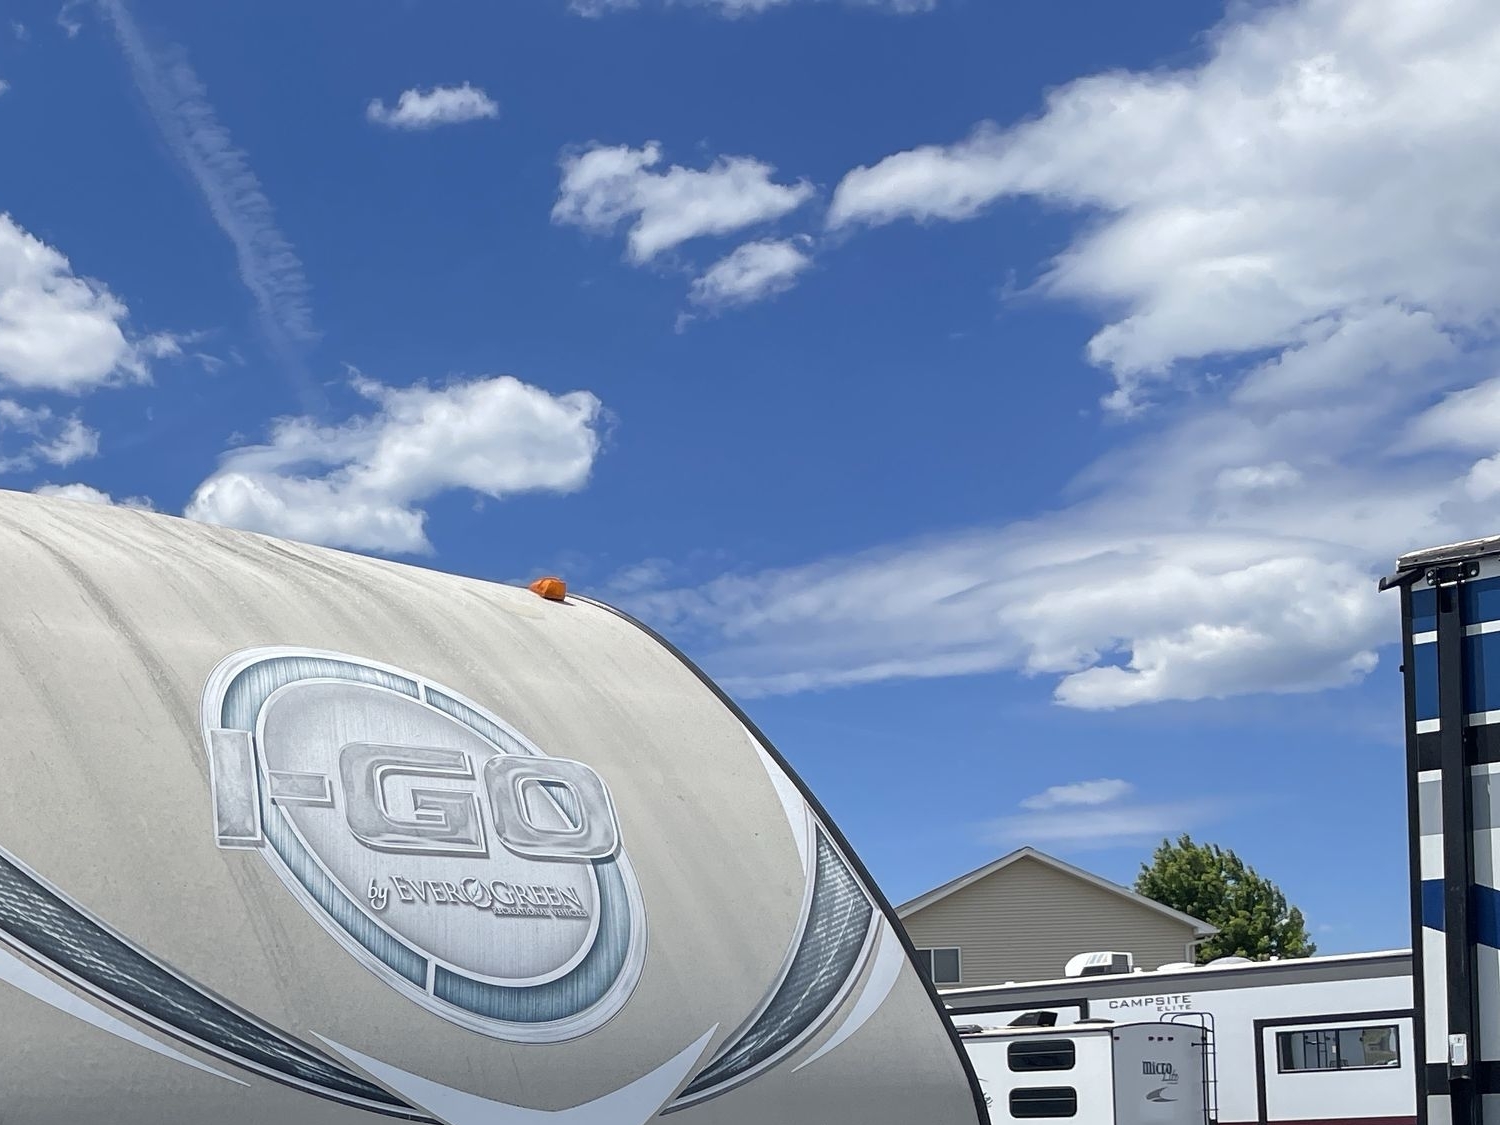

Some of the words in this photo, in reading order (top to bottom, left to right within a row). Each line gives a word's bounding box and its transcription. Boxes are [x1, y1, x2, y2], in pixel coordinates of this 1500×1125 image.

[209, 728, 620, 861] I-GO
[367, 878, 388, 910] by
[1108, 994, 1192, 1010] CAMPSITE
[1156, 1004, 1192, 1012] ELITE
